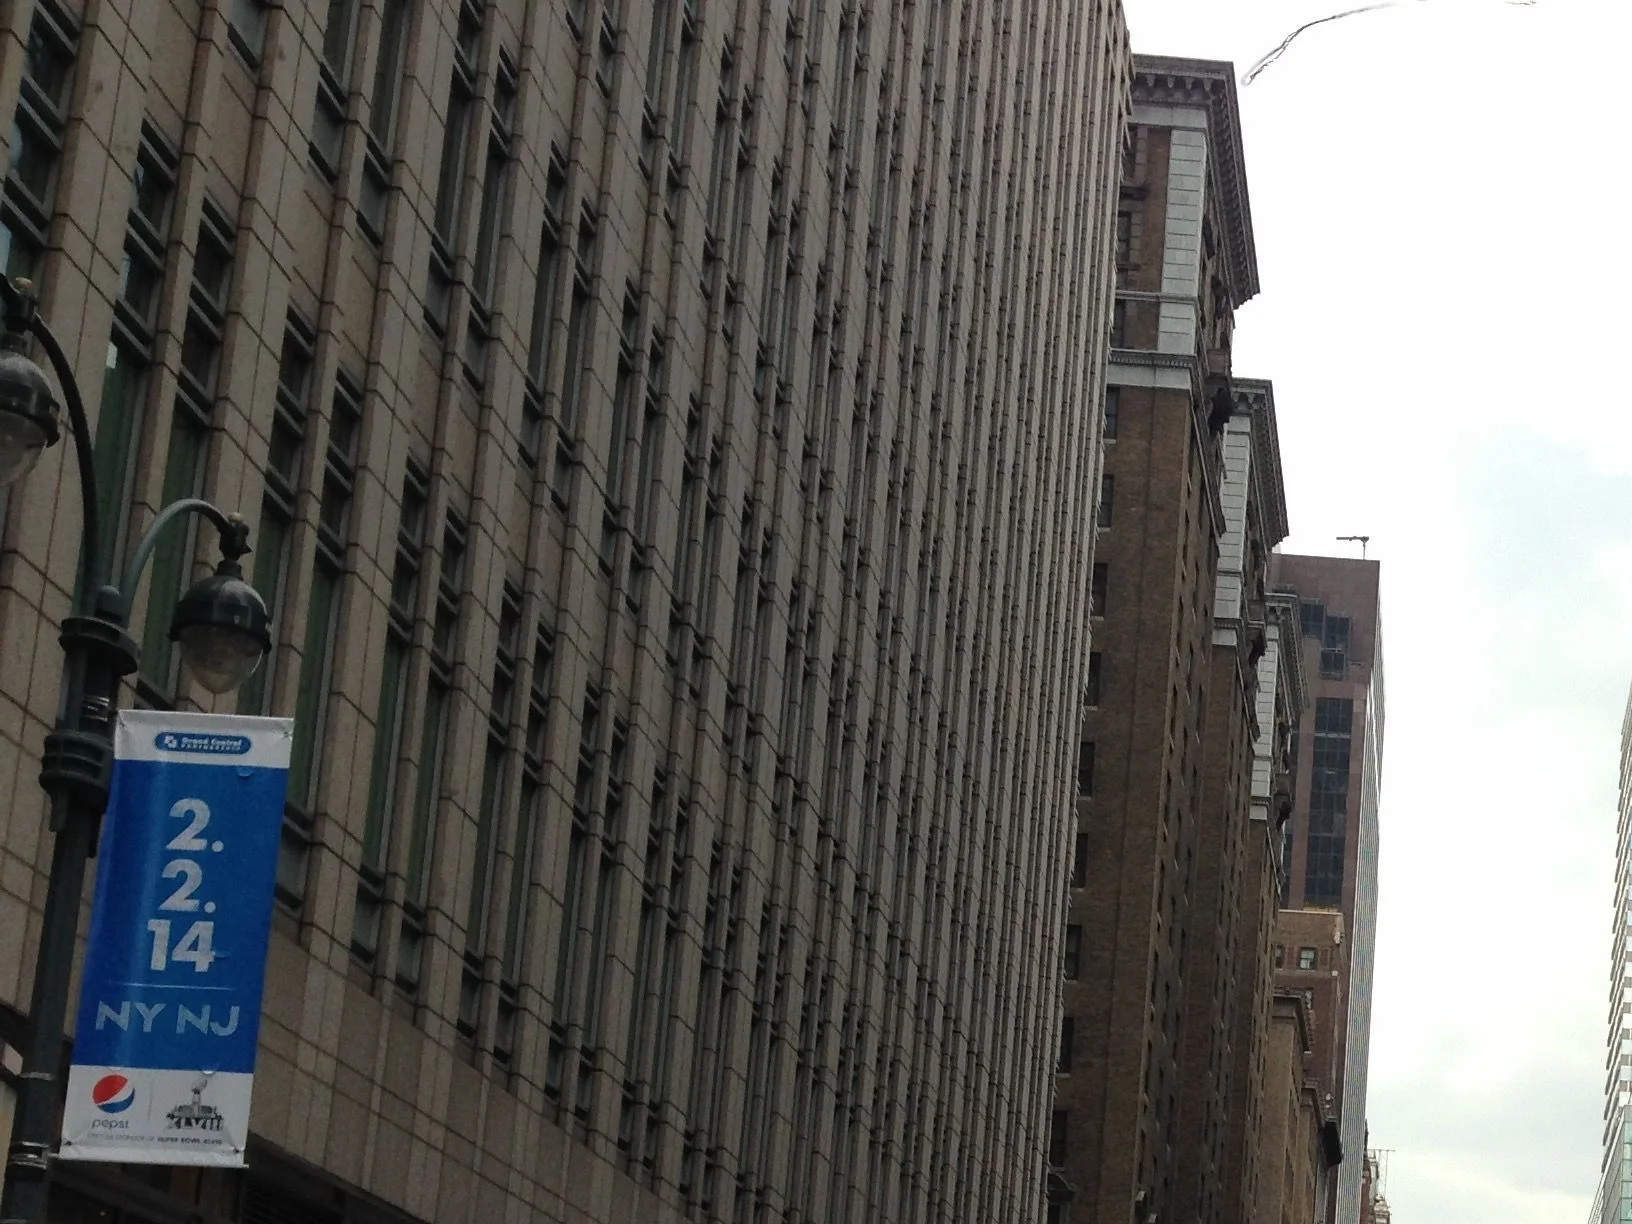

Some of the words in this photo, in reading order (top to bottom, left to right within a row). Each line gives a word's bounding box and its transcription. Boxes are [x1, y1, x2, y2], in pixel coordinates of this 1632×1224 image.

[166, 798, 224, 852] 2.
[158, 859, 216, 913] 2.
[147, 919, 215, 972] 14
[95, 1001, 166, 1033] NY
[176, 1004, 240, 1036] NJ
[91, 1119, 129, 1130] pepsi
